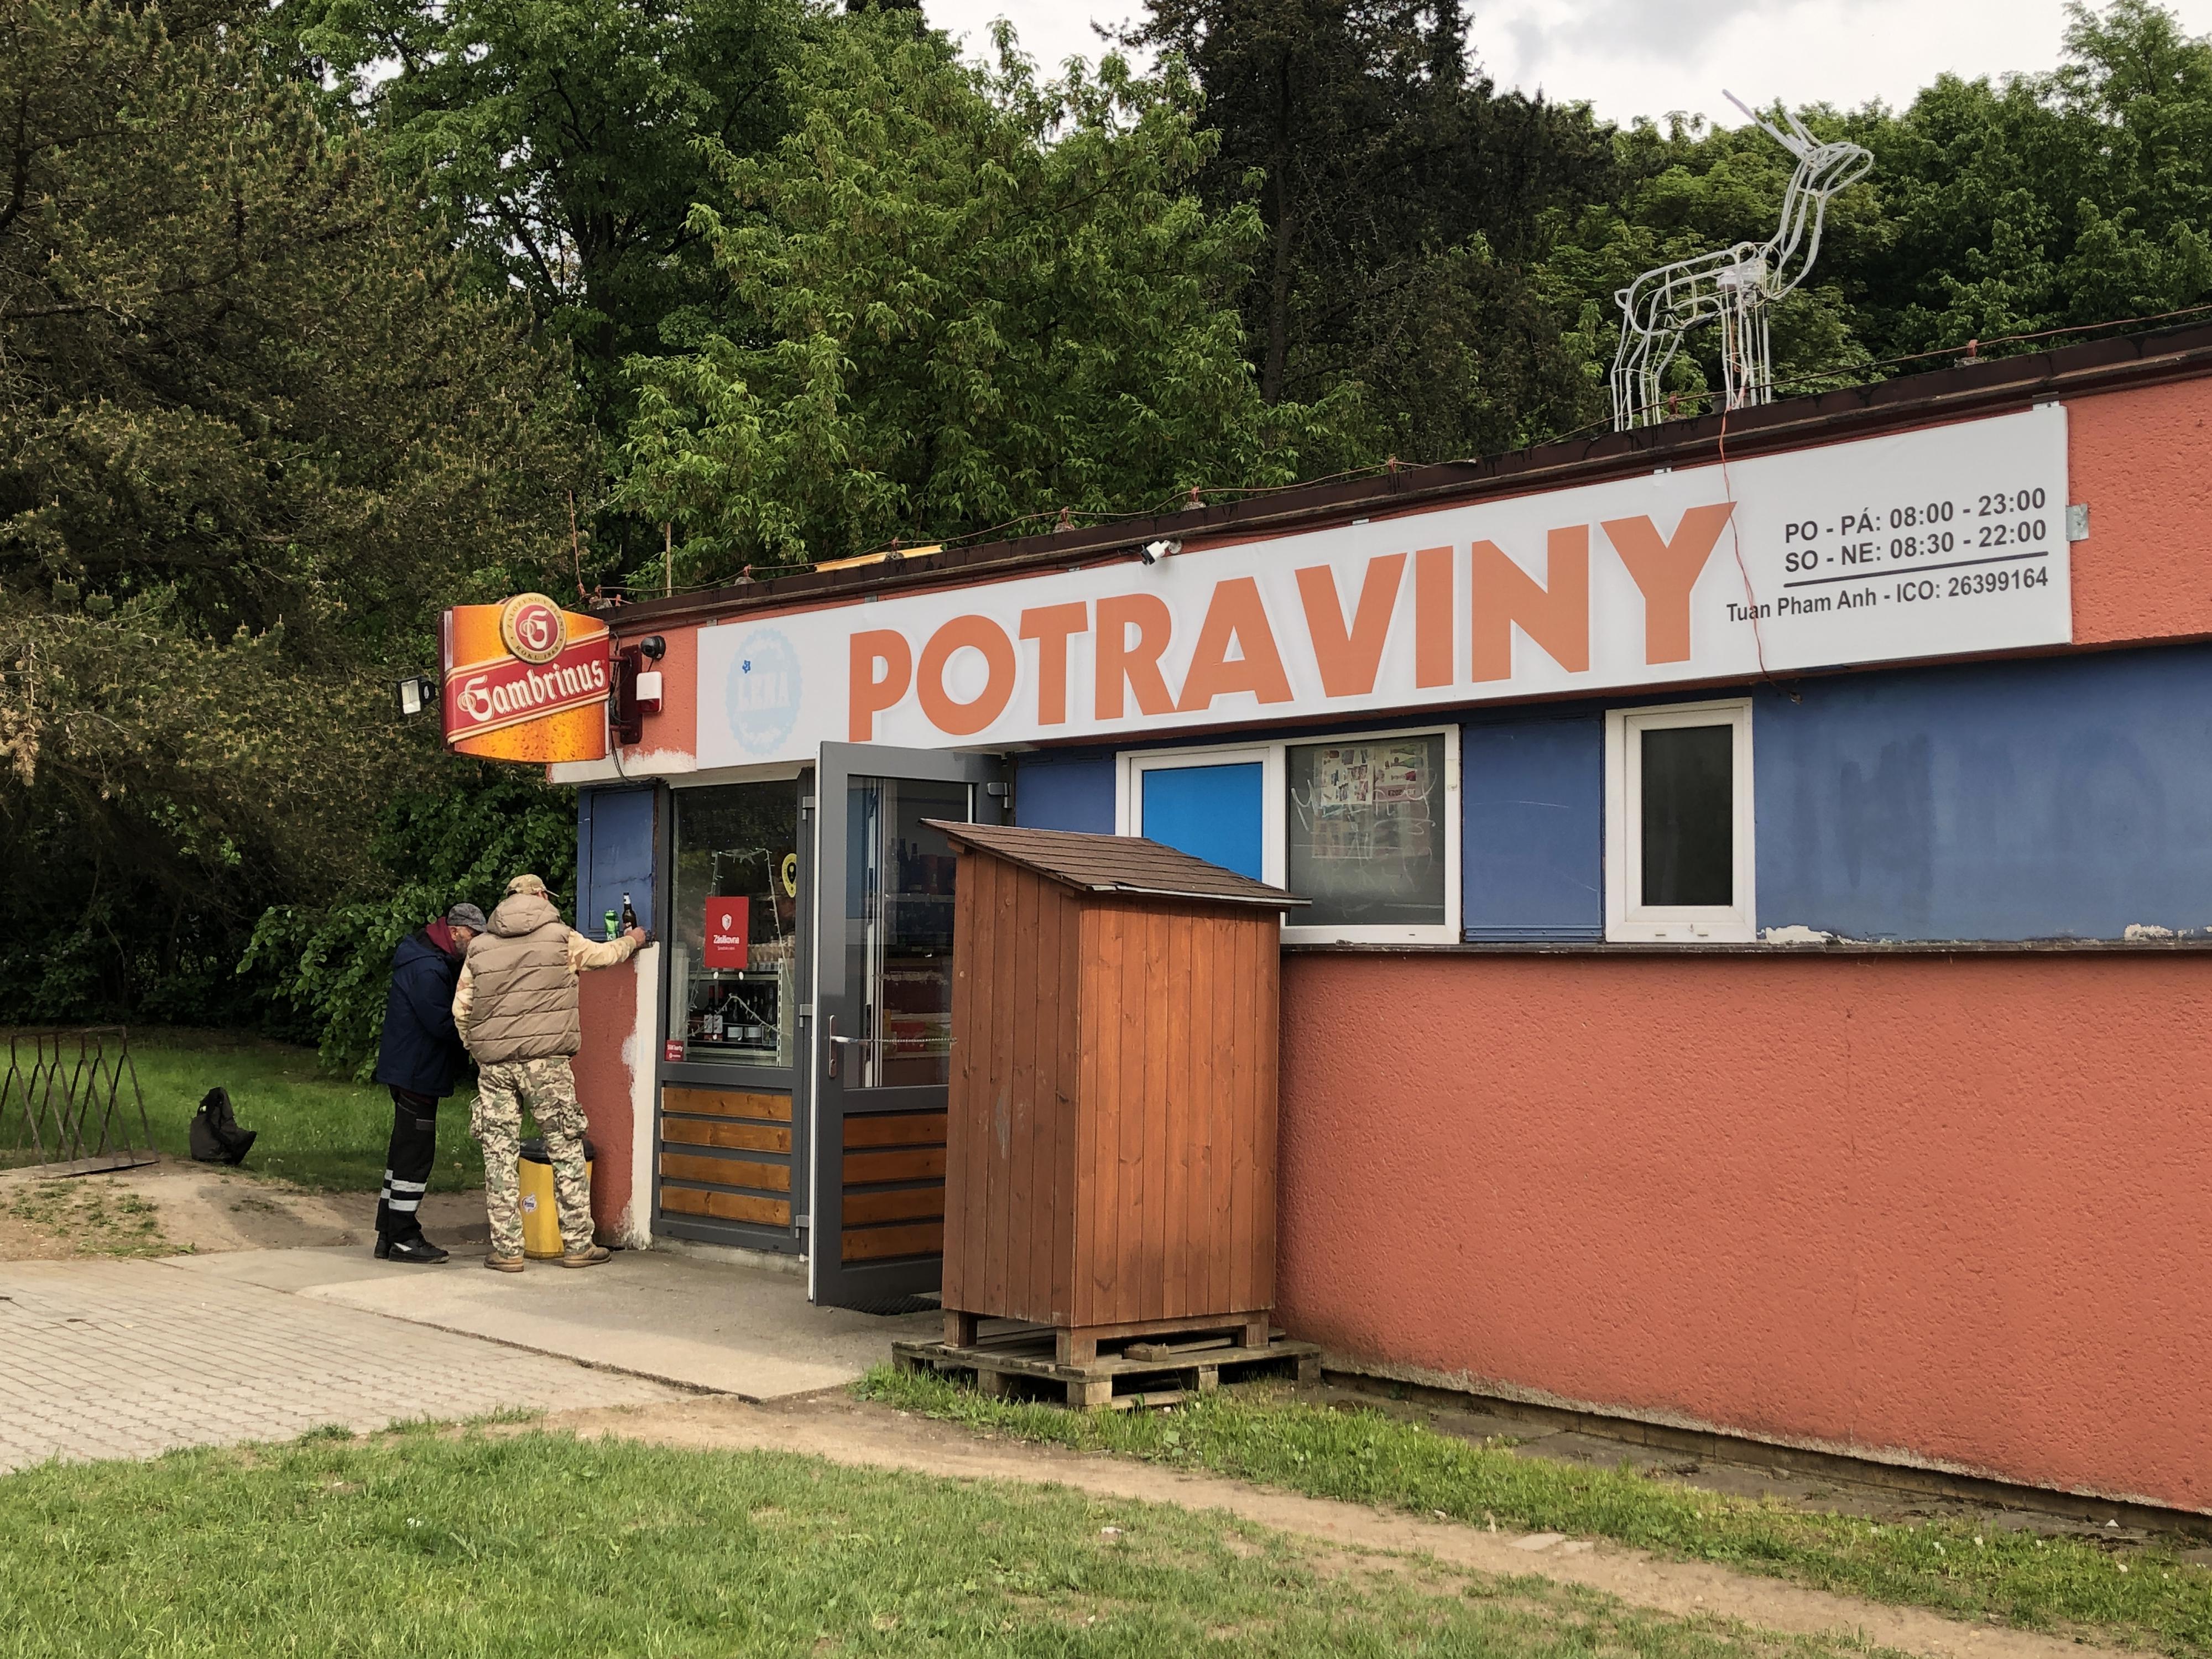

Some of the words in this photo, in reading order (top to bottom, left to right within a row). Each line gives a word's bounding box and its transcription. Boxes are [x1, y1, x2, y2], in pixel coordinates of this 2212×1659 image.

[1786, 520, 1818, 544] PO
[1841, 507, 1880, 536] PÁ:
[1890, 500, 1954, 529] 08:00
[1978, 487, 2046, 517] 23:00
[1785, 550, 1818, 572] SO
[1841, 542, 1881, 565] NE:
[1890, 531, 1954, 559] 08:30
[1978, 519, 2047, 548] 22:00
[849, 500, 1738, 743] POTRAVINY
[1726, 603, 1770, 622] Tuan
[1777, 596, 1832, 617] Pham
[1837, 587, 1877, 610] Anh
[1896, 580, 1940, 603] ICO:
[1948, 566, 2049, 597] 26399164
[457, 659, 606, 722] Gambrinus
